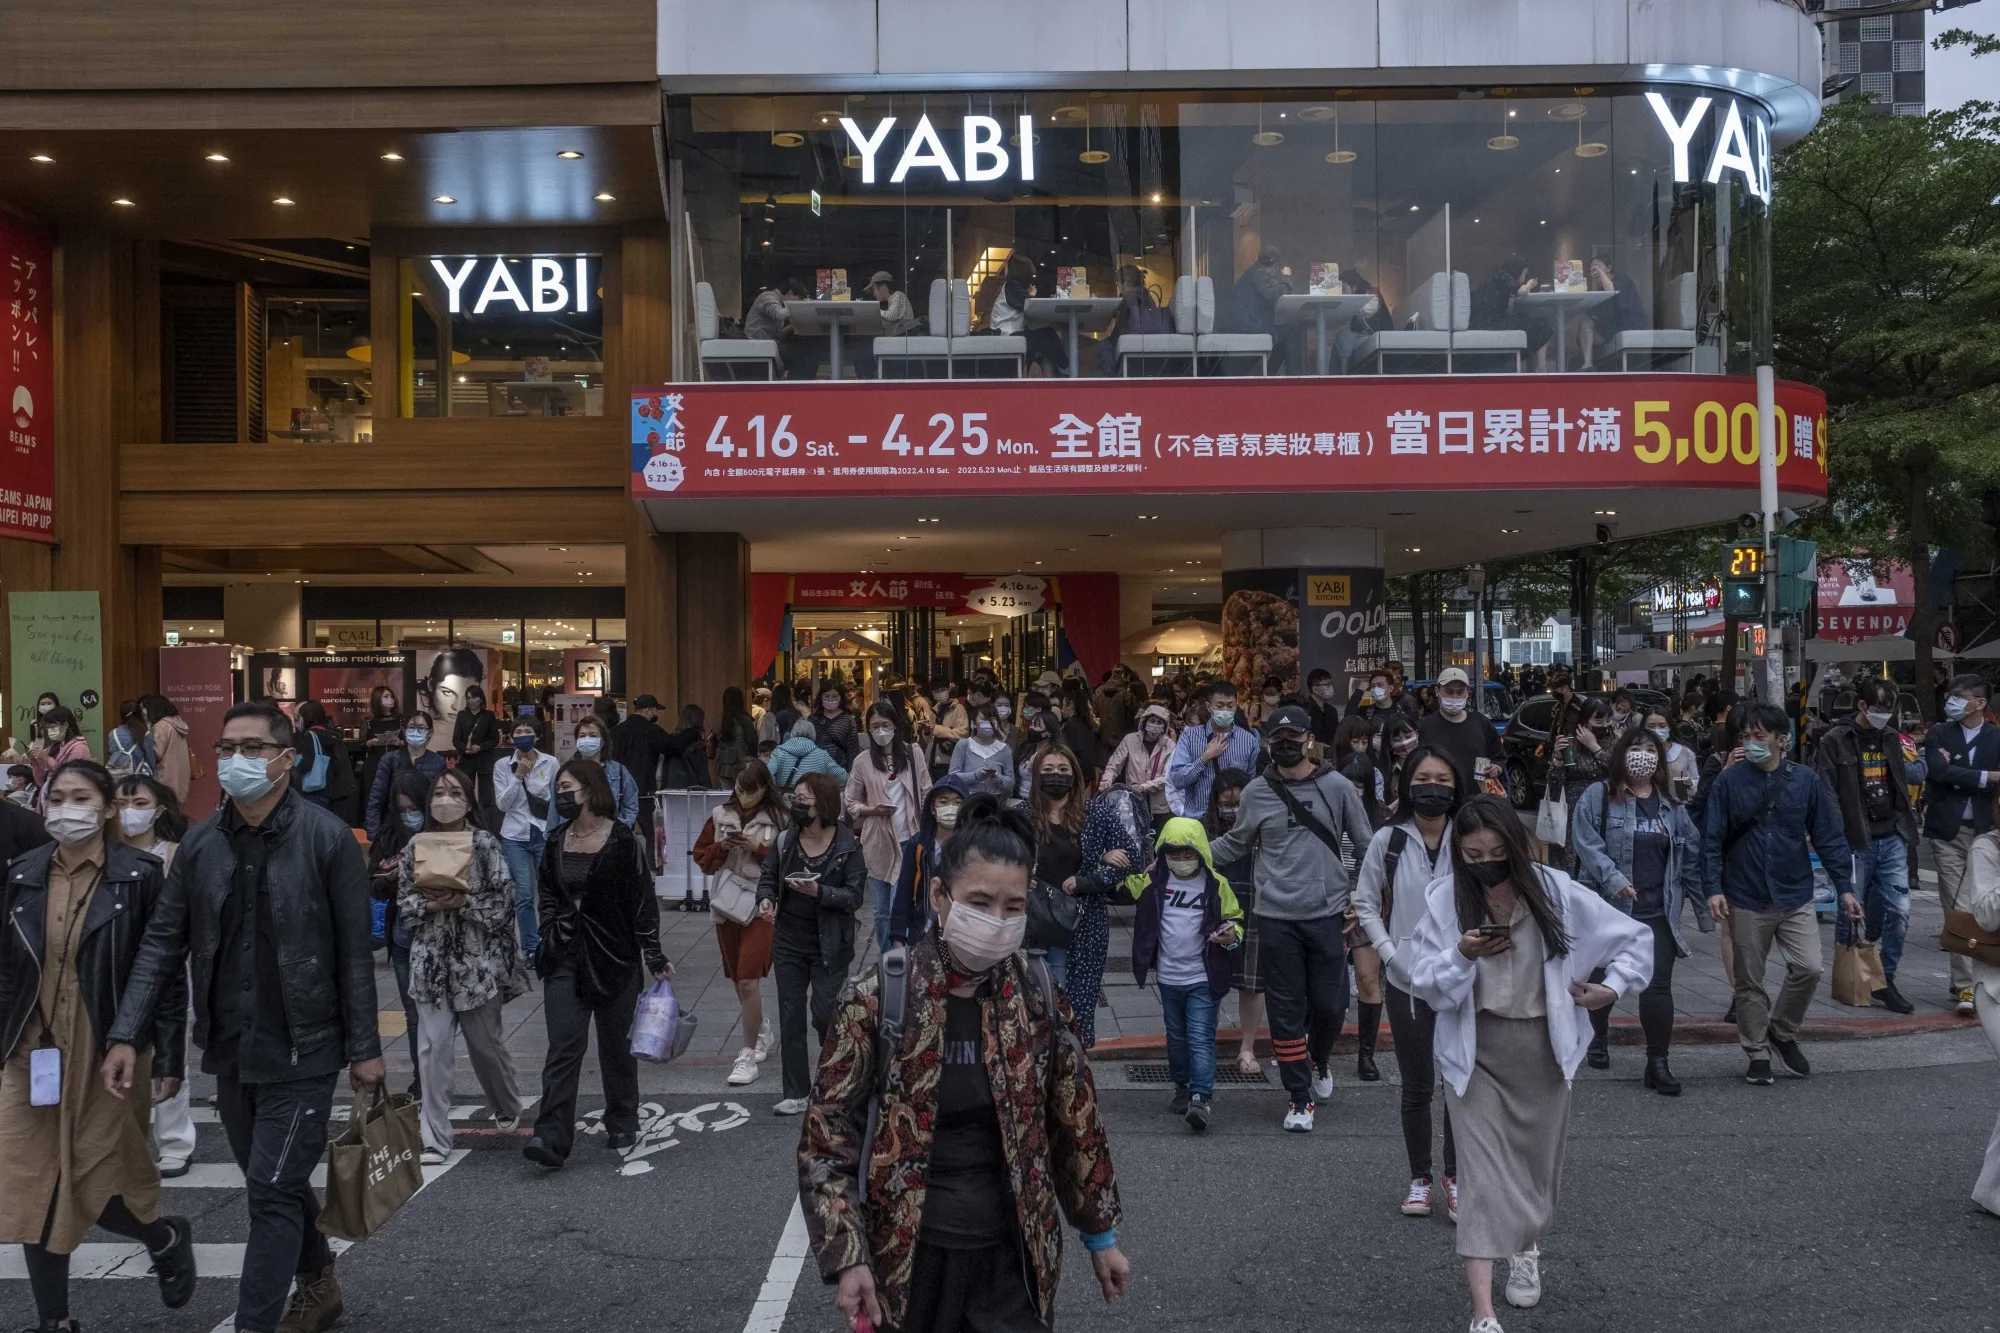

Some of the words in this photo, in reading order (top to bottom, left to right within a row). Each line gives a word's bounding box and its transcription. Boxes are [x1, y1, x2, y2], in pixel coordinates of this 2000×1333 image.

[838, 113, 1035, 184] YABI
[429, 256, 589, 314] YABI
[665, 392, 686, 452] 女人節
[9, 430, 37, 448] BEAMS
[705, 414, 798, 458] 4.16
[805, 440, 839, 457] Sat.
[881, 412, 989, 457] 4.25
[997, 438, 1039, 456] Mon.
[1049, 411, 1142, 459] 全館
[1386, 406, 1622, 455] 當日累計滿
[1793, 413, 1813, 461] 贈
[649, 460, 668, 468] 4.16
[647, 474, 667, 483] 5.23
[0, 487, 22, 507] EAMS
[23, 493, 53, 512] JAPAN
[0, 507, 19, 525] AIPEI
[21, 511, 39, 528] POP
[40, 514, 52, 530] UP
[1730, 548, 1757, 576] 27
[849, 579, 909, 601] 女人節
[999, 581, 1024, 591] 4.16
[1313, 581, 1345, 594] YABI
[990, 596, 1016, 607] 5.23
[1817, 615, 1906, 630] SEVENDA
[305, 655, 348, 663] narciso
[351, 654, 406, 664] rodriguez
[82, 694, 98, 705] KA
[191, 695, 225, 703] rodriguez
[944, 1040, 976, 1065] VIN
[367, 1167, 386, 1186] TE
[387, 1148, 413, 1173] BAG
